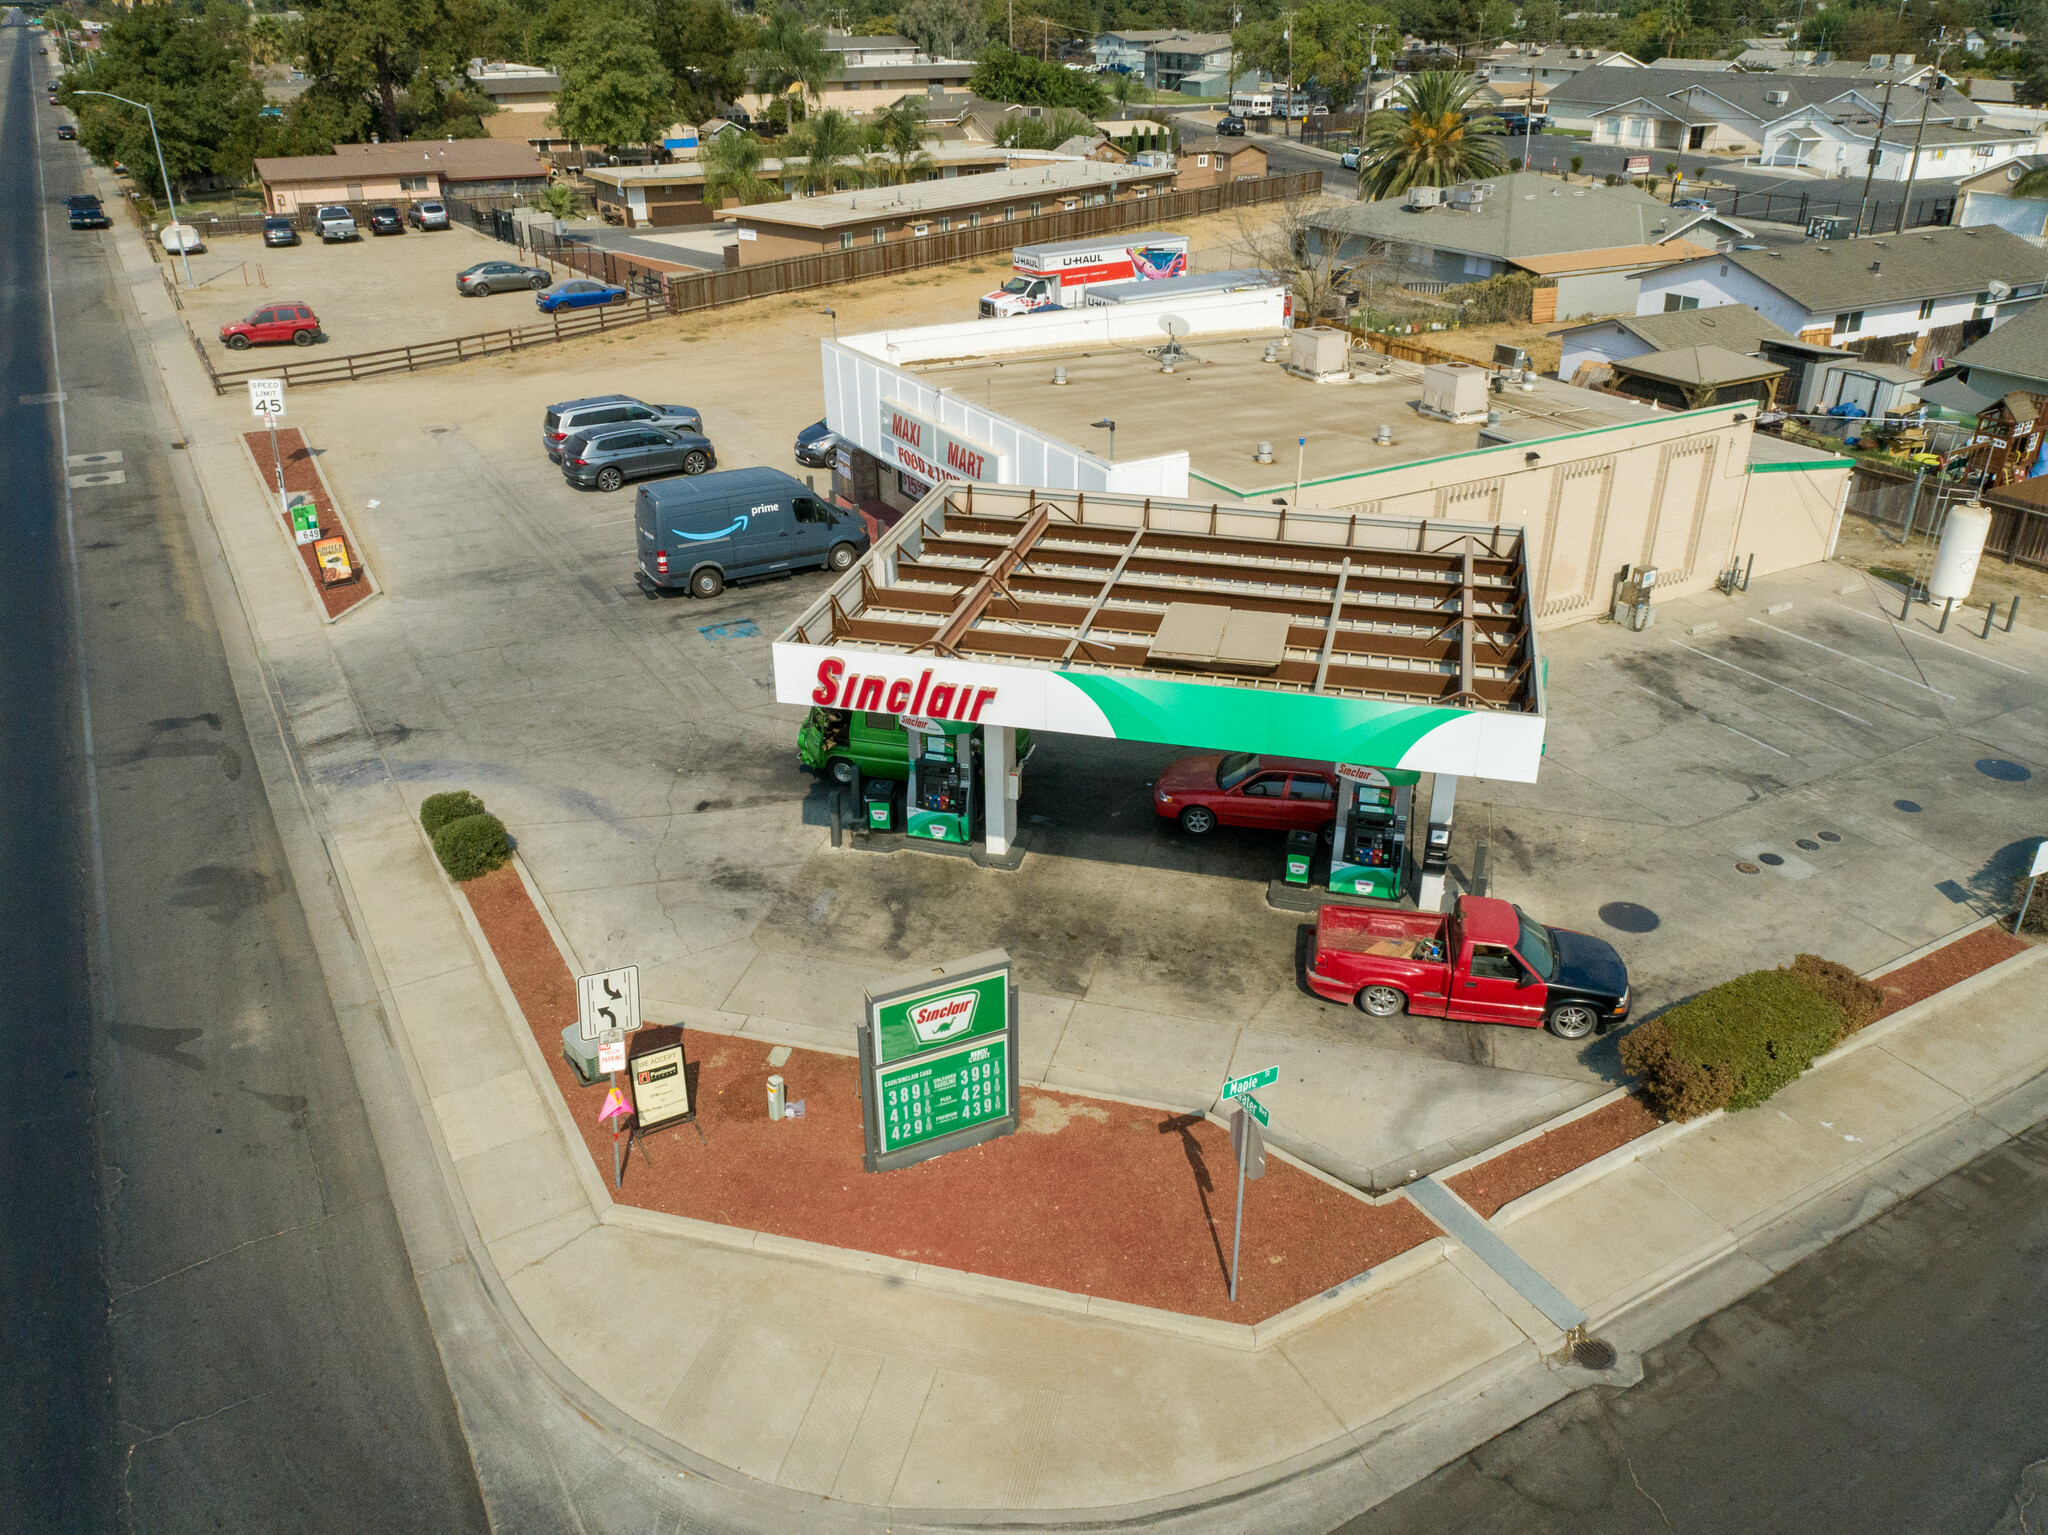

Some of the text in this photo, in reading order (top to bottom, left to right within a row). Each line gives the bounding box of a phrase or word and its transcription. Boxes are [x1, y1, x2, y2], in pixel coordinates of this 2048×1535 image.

[1014, 255, 1038, 268] U-HAUL
[1062, 254, 1104, 266] U-HAUL
[255, 400, 282, 412] 45
[892, 413, 921, 448] MAXI
[898, 446, 925, 474] FOOD
[928, 464, 935, 480] &
[948, 441, 984, 480] MART
[751, 503, 779, 516] prime
[812, 656, 998, 722] Sinclair
[901, 715, 928, 729] Sinclair
[1338, 763, 1372, 780] Sinclair
[917, 1000, 972, 1024] Sinclair
[602, 1054, 623, 1063] PARKING
[651, 1052, 676, 1065] ACCEPT
[969, 1052, 990, 1063] CREDIT
[961, 1063, 990, 1085] 399
[889, 1084, 920, 1106] 389
[961, 1081, 991, 1101] 429
[1230, 1077, 1258, 1095] Maple
[890, 1102, 921, 1122] 419
[962, 1098, 992, 1118] 439
[1238, 1094, 1257, 1114] ater
[892, 1120, 922, 1140] 429
